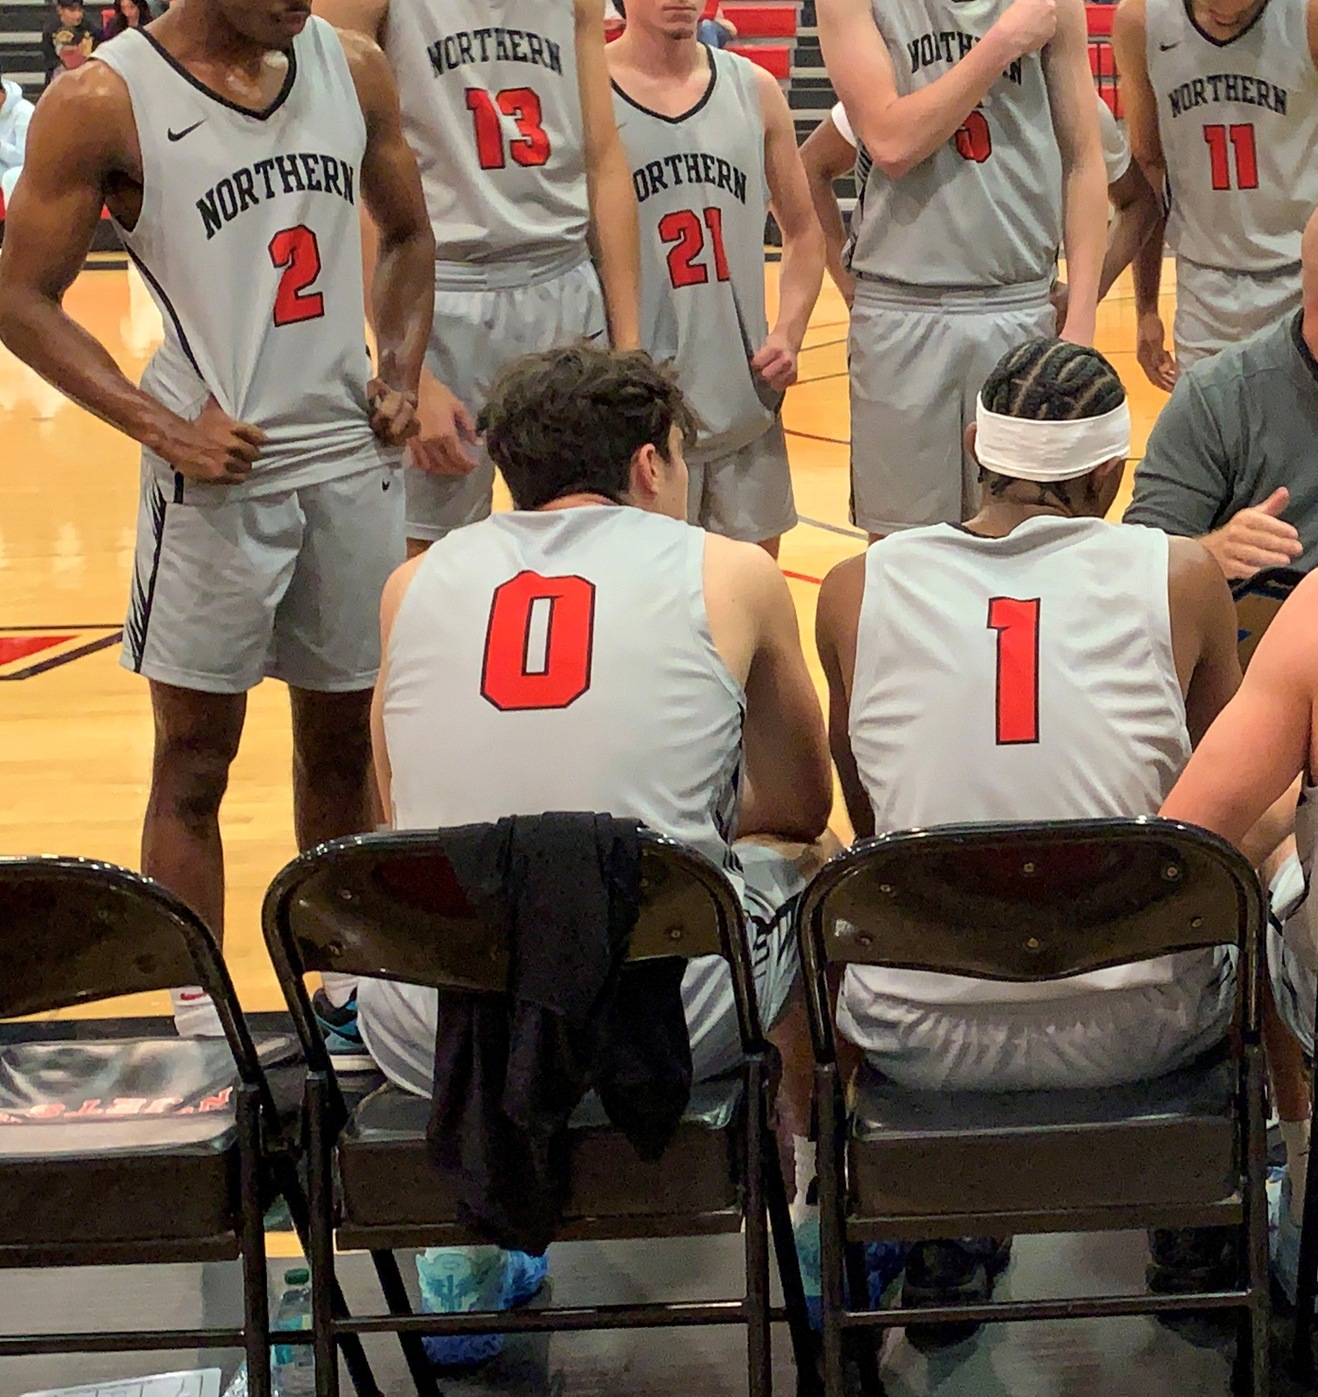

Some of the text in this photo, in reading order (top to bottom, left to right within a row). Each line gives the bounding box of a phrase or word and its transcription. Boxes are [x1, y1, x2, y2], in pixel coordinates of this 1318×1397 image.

[427, 27, 563, 78] NORTHERN
[464, 86, 552, 170] 13
[1168, 73, 1287, 118] NORTHERN
[196, 153, 354, 240] NORTHERN
[632, 153, 747, 205] ORTHERN
[1203, 123, 1258, 190] 11
[268, 224, 325, 327] 2
[658, 206, 730, 289] 21
[480, 570, 596, 712] 0
[987, 596, 1041, 745] 1
